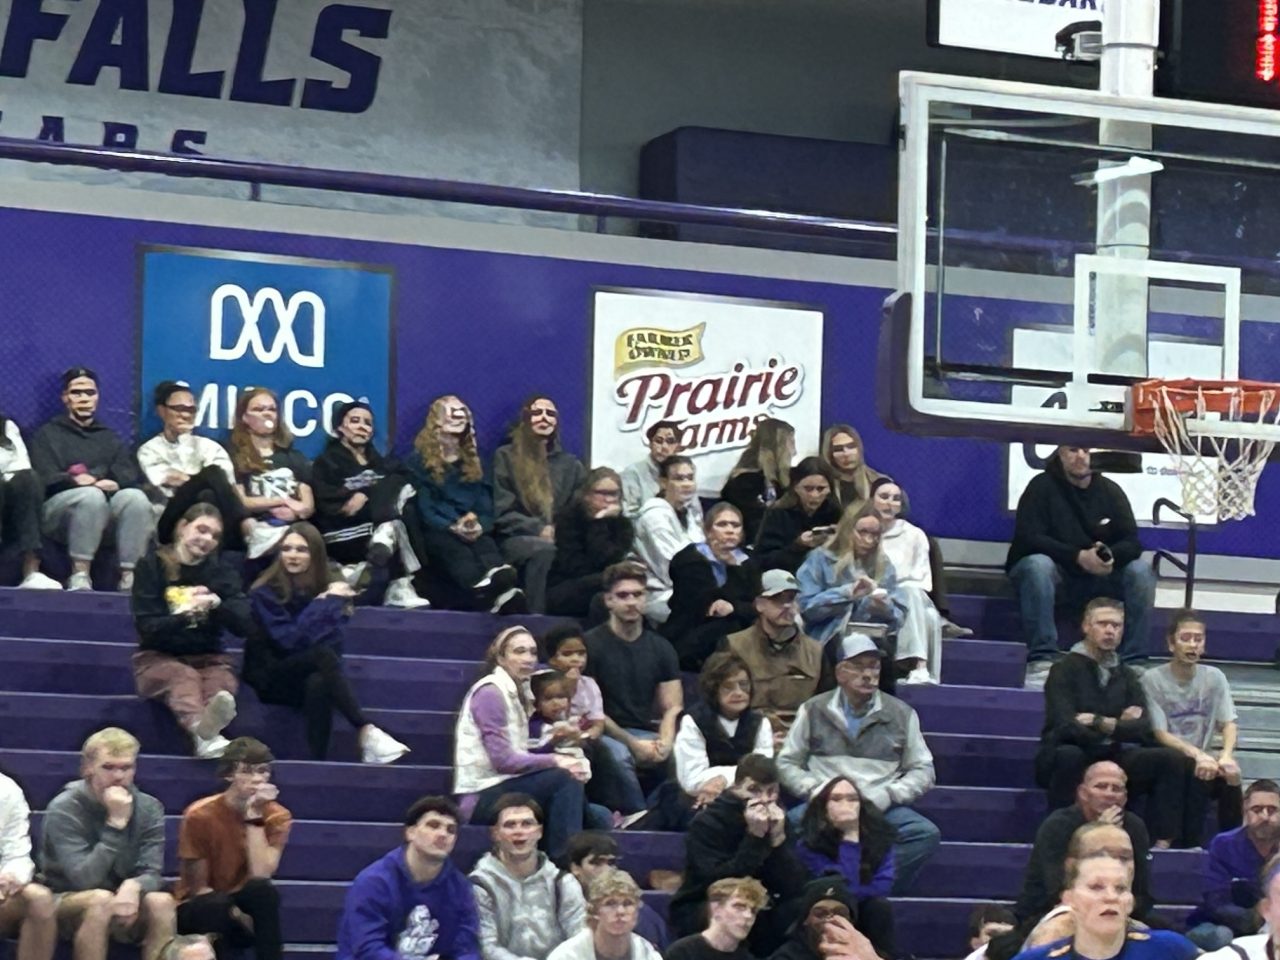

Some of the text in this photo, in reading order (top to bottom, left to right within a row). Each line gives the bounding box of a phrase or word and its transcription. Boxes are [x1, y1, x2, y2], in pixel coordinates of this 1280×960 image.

[0, 0, 393, 114] FALLS
[616, 357, 798, 424] Prairie
[662, 413, 770, 449] arms
